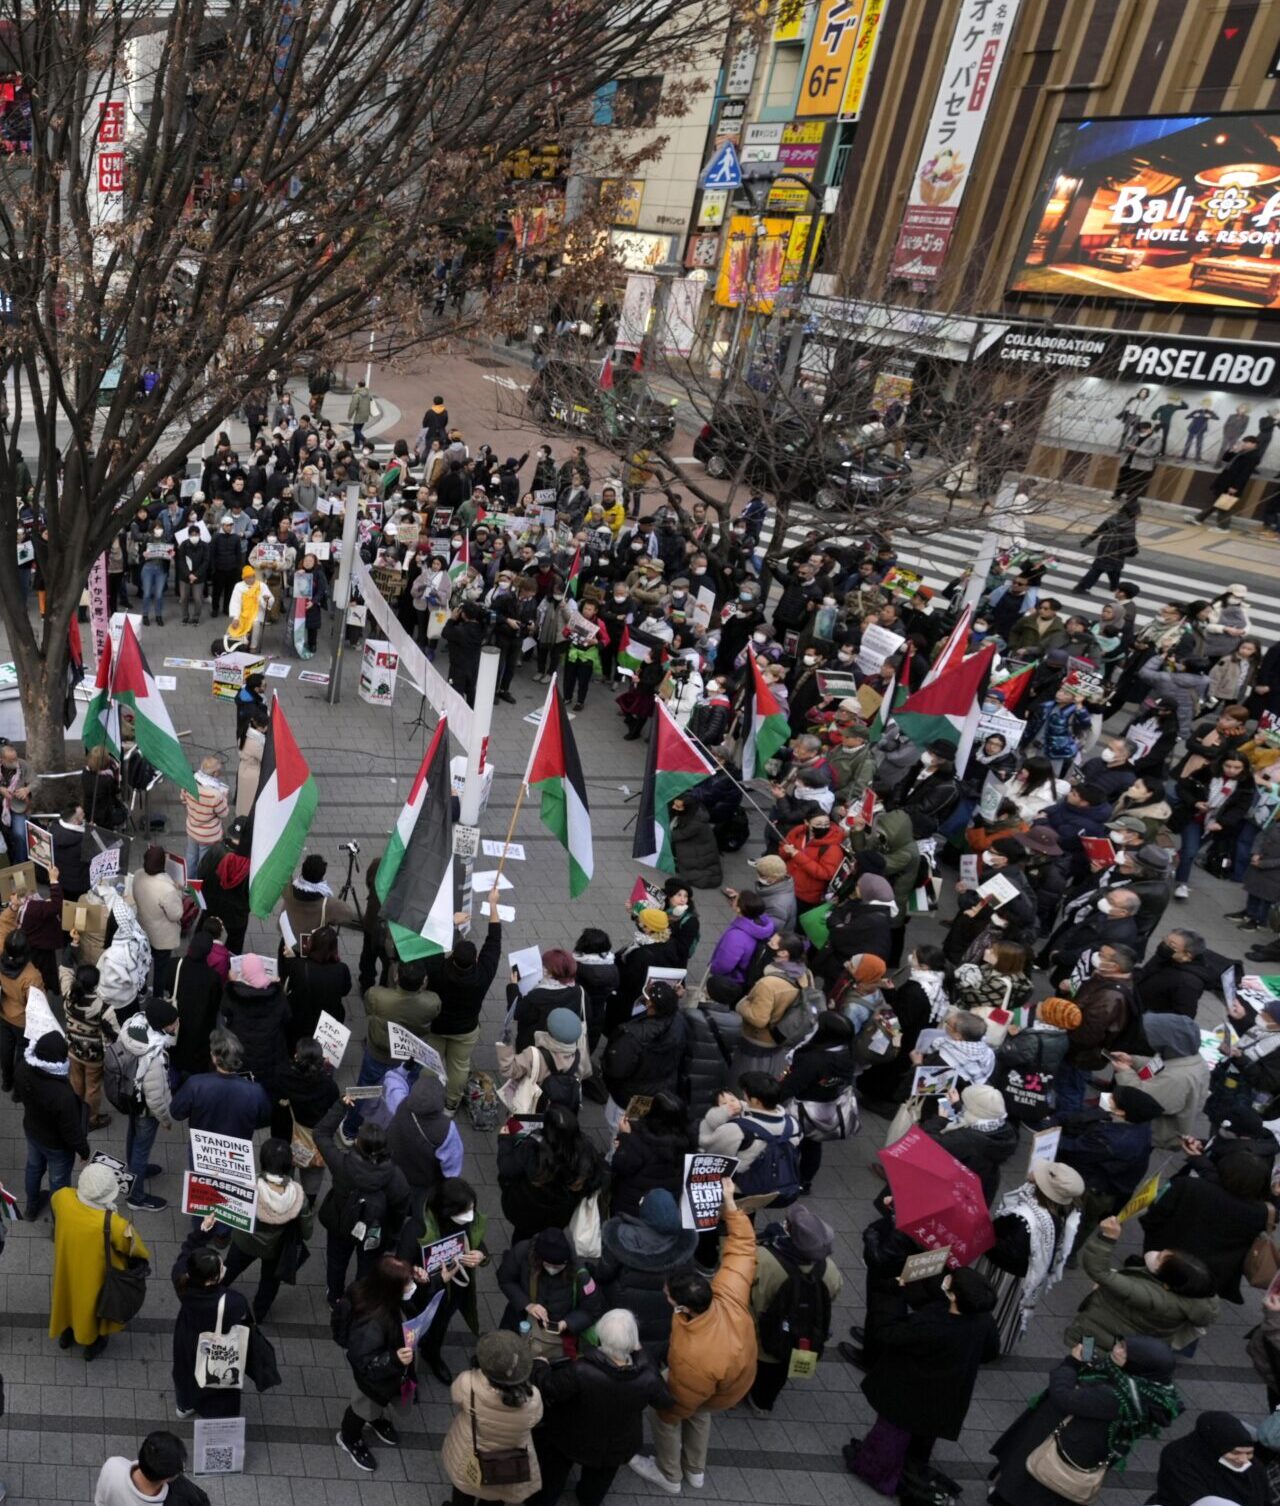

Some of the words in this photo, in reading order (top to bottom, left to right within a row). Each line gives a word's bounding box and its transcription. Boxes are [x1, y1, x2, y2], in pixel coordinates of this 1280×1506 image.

[808, 64, 841, 97] 6F
[1109, 186, 1195, 224] Bali
[1136, 228, 1189, 242] HOTEL
[1195, 231, 1209, 243] &
[1004, 333, 1105, 354] COLLABORATION
[1000, 348, 1029, 363] CAFE
[1031, 350, 1041, 363] &
[1043, 352, 1091, 368] STORES
[1118, 344, 1276, 387] PASELABO
[194, 1134, 250, 1153] STANDING
[201, 1145, 227, 1157] WITH
[196, 1153, 252, 1173] PALESTINE
[191, 1176, 253, 1200] #CEASEFIRE
[692, 1189, 723, 1204] ELBIT
[189, 1203, 208, 1211] FREE
